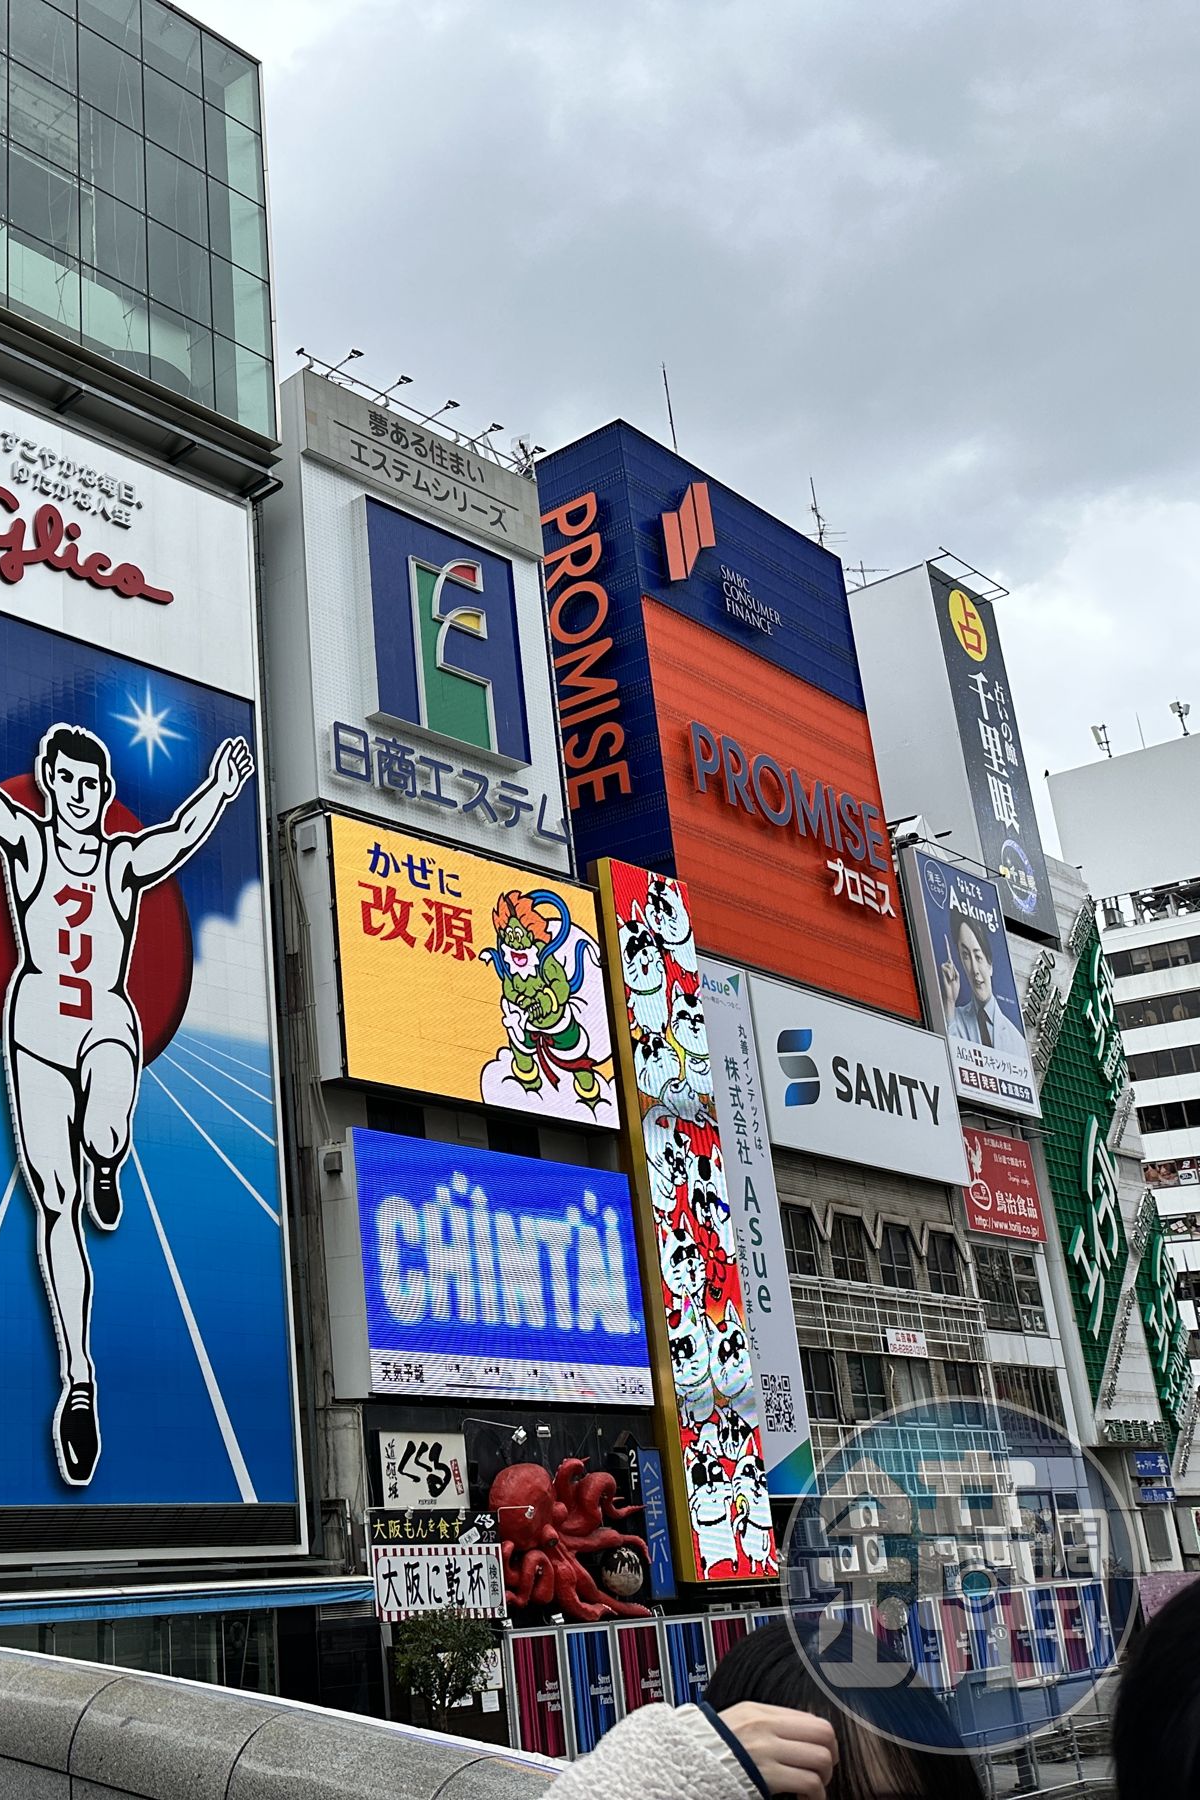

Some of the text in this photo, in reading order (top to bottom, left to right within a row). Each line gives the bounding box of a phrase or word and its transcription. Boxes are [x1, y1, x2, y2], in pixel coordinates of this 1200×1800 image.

[0, 430, 143, 510] すこやかな毎日、
[368, 409, 485, 484] 夢ある住まい
[11, 460, 132, 530] ゆたかな人生
[350, 439, 508, 533] エステムシリーズ
[720, 564, 750, 593] SMBC
[723, 581, 783, 627] CONSUMER
[726, 598, 773, 636] FINANCE
[958, 593, 983, 655] 占
[541, 491, 632, 810] PROMISE
[330, 720, 570, 846] 日商エステム
[968, 671, 1020, 835] 千里眼
[689, 720, 889, 873] PROMISE
[367, 841, 462, 898] かぜに
[827, 857, 896, 918] プロミス
[358, 880, 476, 961] 改源
[949, 885, 999, 932] Asking!
[53, 882, 96, 1021] グリコ
[701, 973, 731, 996] Asue
[832, 1055, 940, 1126] SAMTY
[724, 1055, 772, 1314] 株式会社 Asue
[398, 1440, 451, 1498] くくる
[629, 1449, 638, 1490] 2F
[373, 1517, 463, 1540] 大阪もんを食す
[482, 1530, 497, 1543] 2F
[643, 1461, 669, 1584] ペンギンバー
[382, 1557, 486, 1607] 大阪に乾杯
